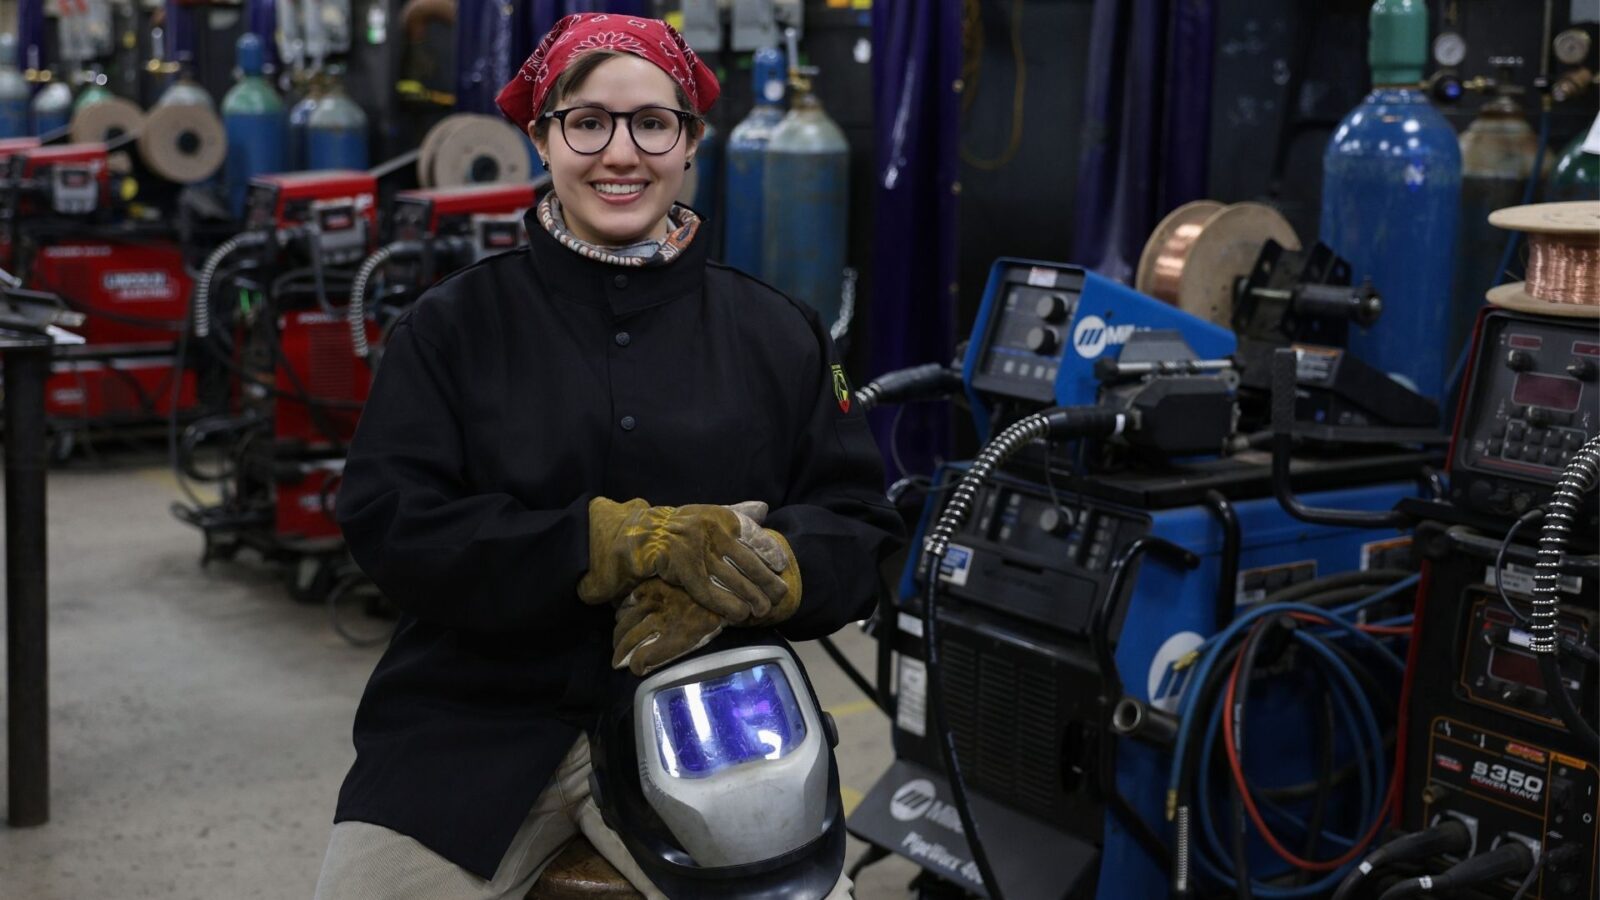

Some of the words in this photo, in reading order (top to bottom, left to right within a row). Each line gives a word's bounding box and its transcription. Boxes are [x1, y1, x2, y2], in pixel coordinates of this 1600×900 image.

[1470, 774, 1507, 791] POWER
[1509, 786, 1540, 802] WAVE
[1472, 760, 1489, 776] S
[1489, 764, 1544, 794] 350
